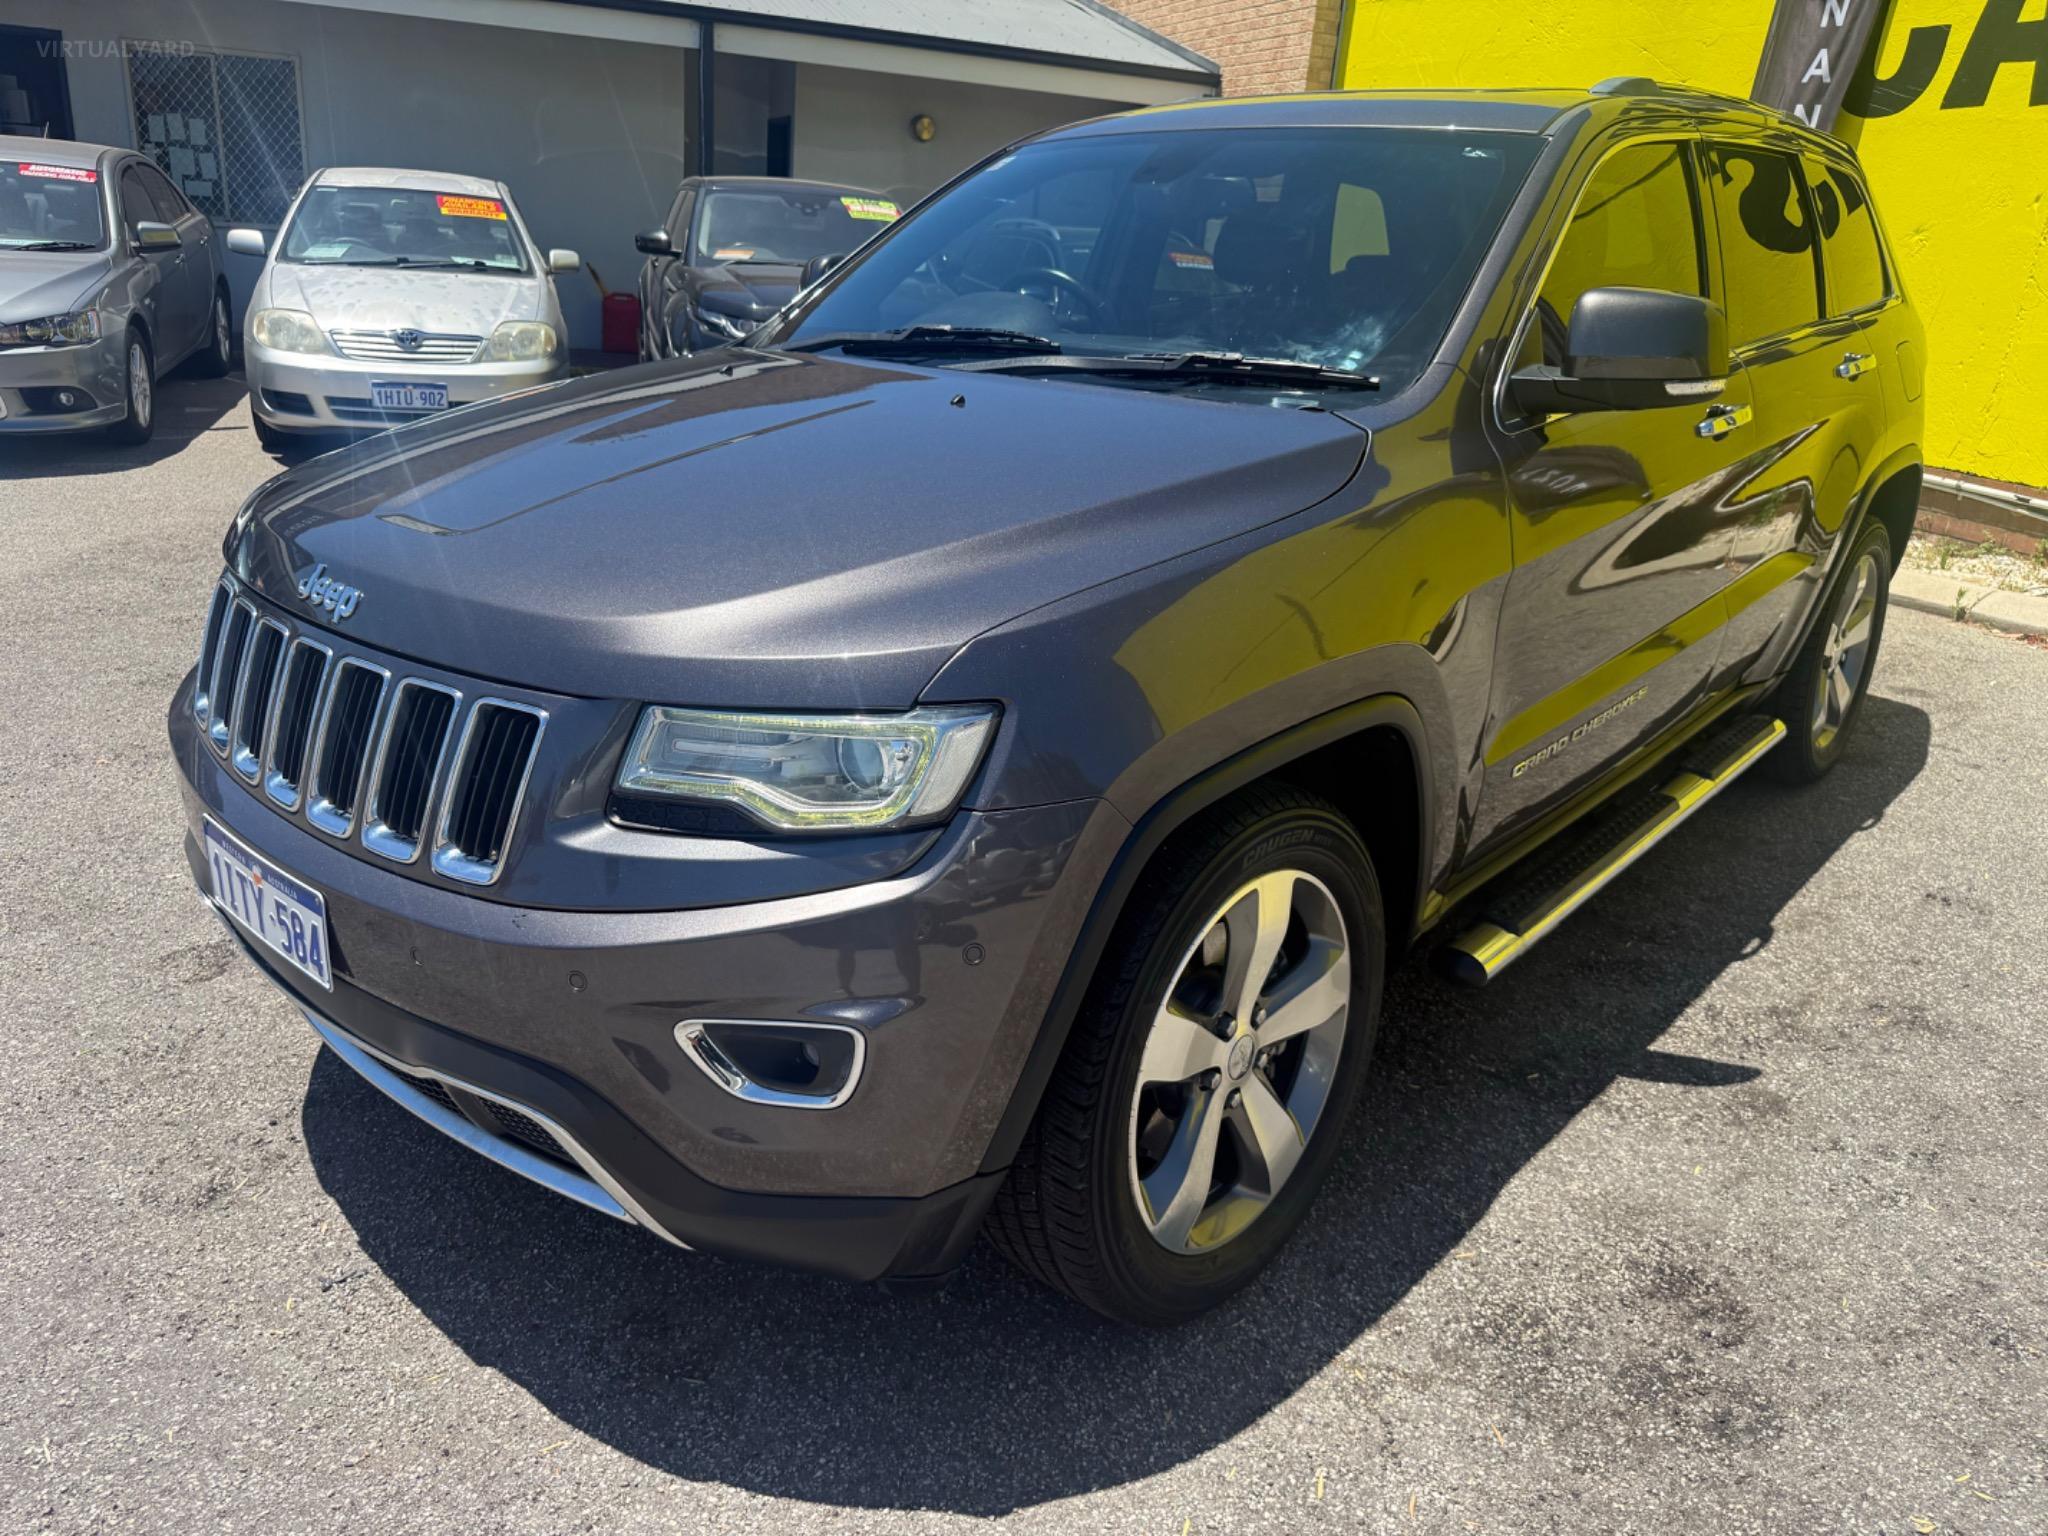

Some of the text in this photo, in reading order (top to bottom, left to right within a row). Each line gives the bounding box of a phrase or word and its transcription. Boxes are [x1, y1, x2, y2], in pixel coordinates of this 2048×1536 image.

[297, 563, 360, 623] Jeep
[1511, 684, 1649, 778] GRAND CHEROKEE
